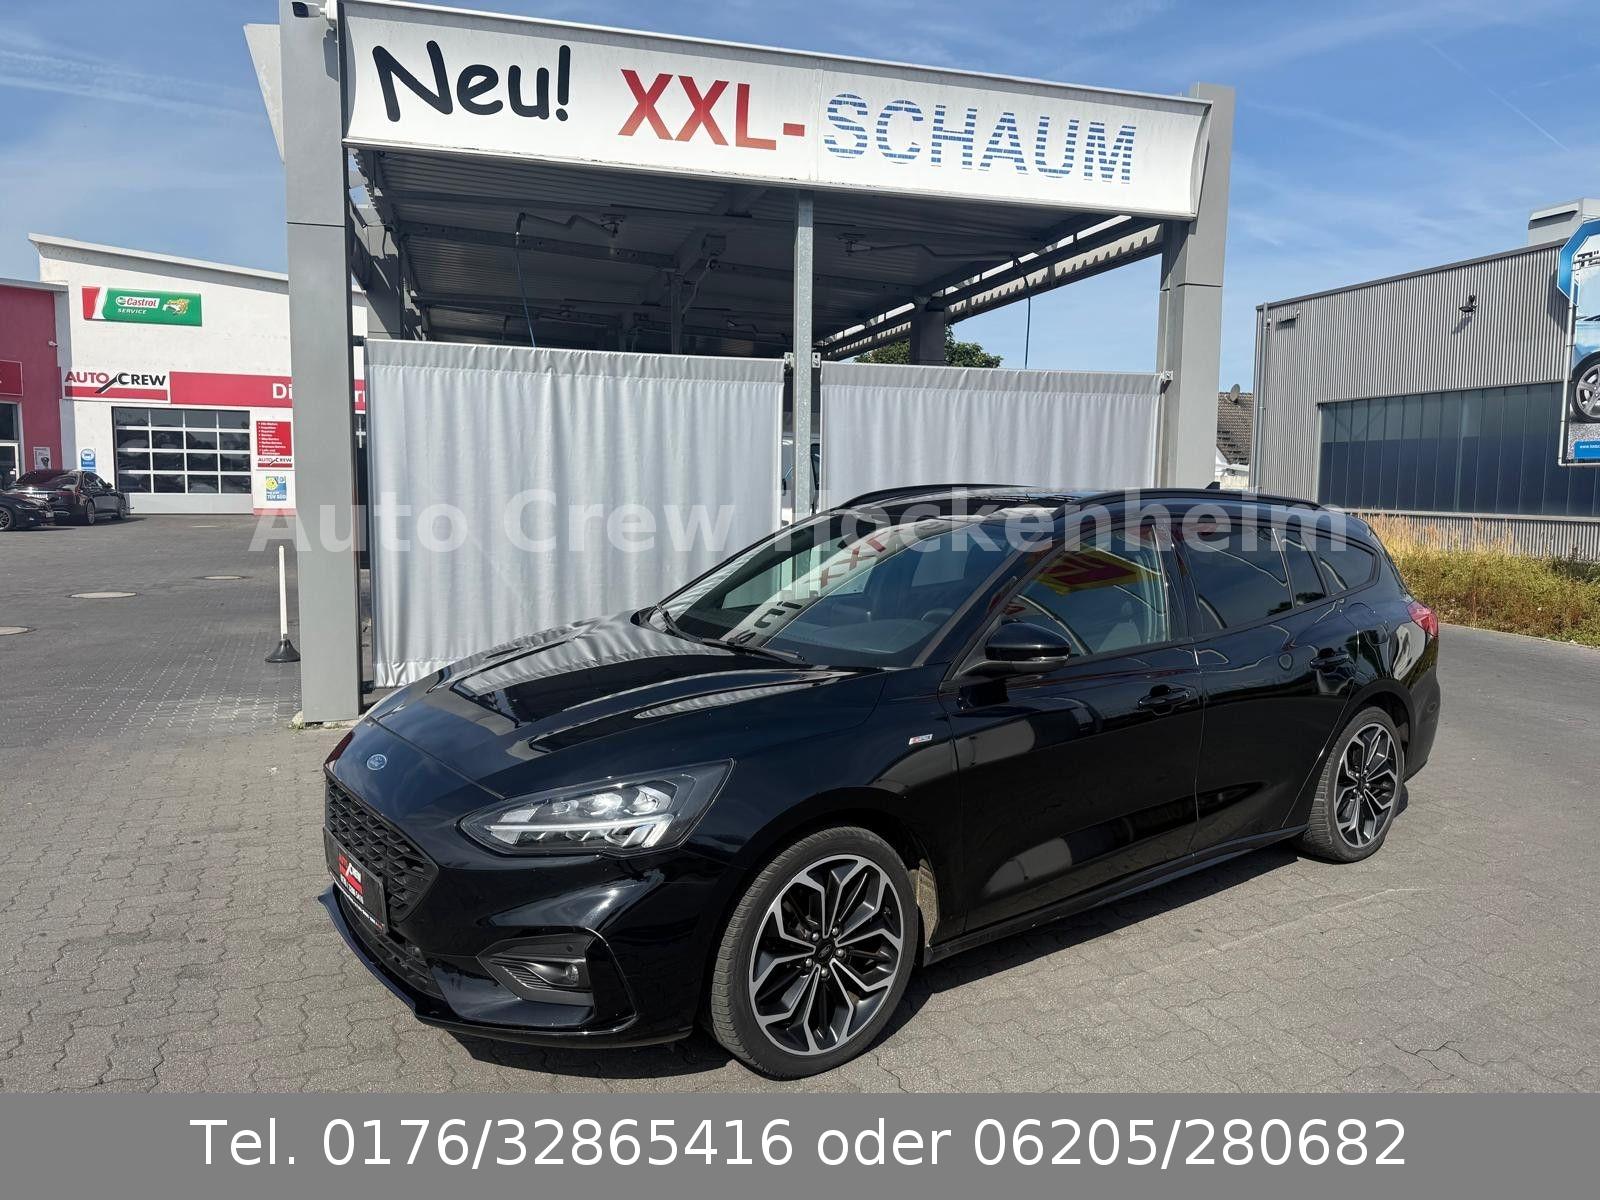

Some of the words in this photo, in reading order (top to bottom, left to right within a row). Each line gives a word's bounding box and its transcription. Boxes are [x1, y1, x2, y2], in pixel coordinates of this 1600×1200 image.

[372, 40, 571, 122] Neu!
[127, 297, 156, 307] Castrol
[64, 371, 110, 384] AUTO
[117, 373, 166, 386] CREW
